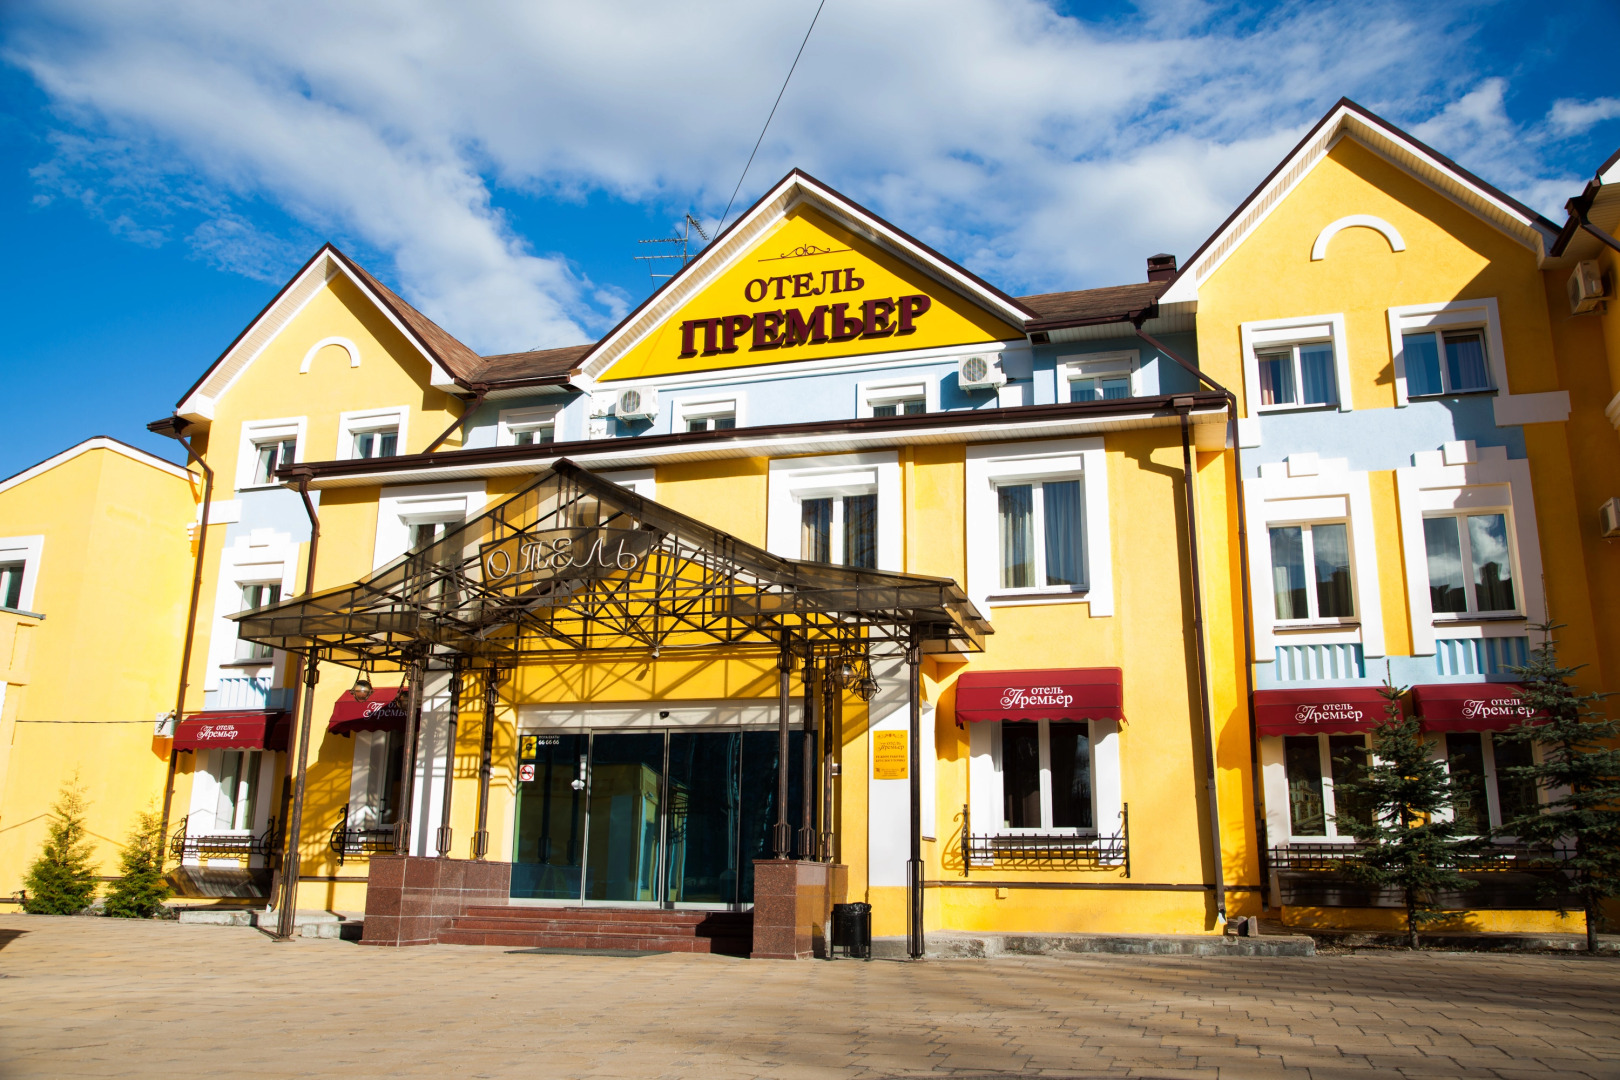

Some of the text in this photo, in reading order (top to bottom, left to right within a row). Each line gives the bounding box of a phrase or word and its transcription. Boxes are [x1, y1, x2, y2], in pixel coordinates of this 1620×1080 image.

[744, 267, 865, 302] ОТЕЛЬ
[678, 294, 932, 359] ПРЕМЬЕР
[486, 536, 638, 580] ОТЕЛЬ
[1000, 687, 1073, 709] Премьер
[1031, 686, 1064, 695] отель
[1295, 704, 1363, 724] Премьер
[1322, 703, 1353, 711] отель
[197, 724, 239, 740] Премьер
